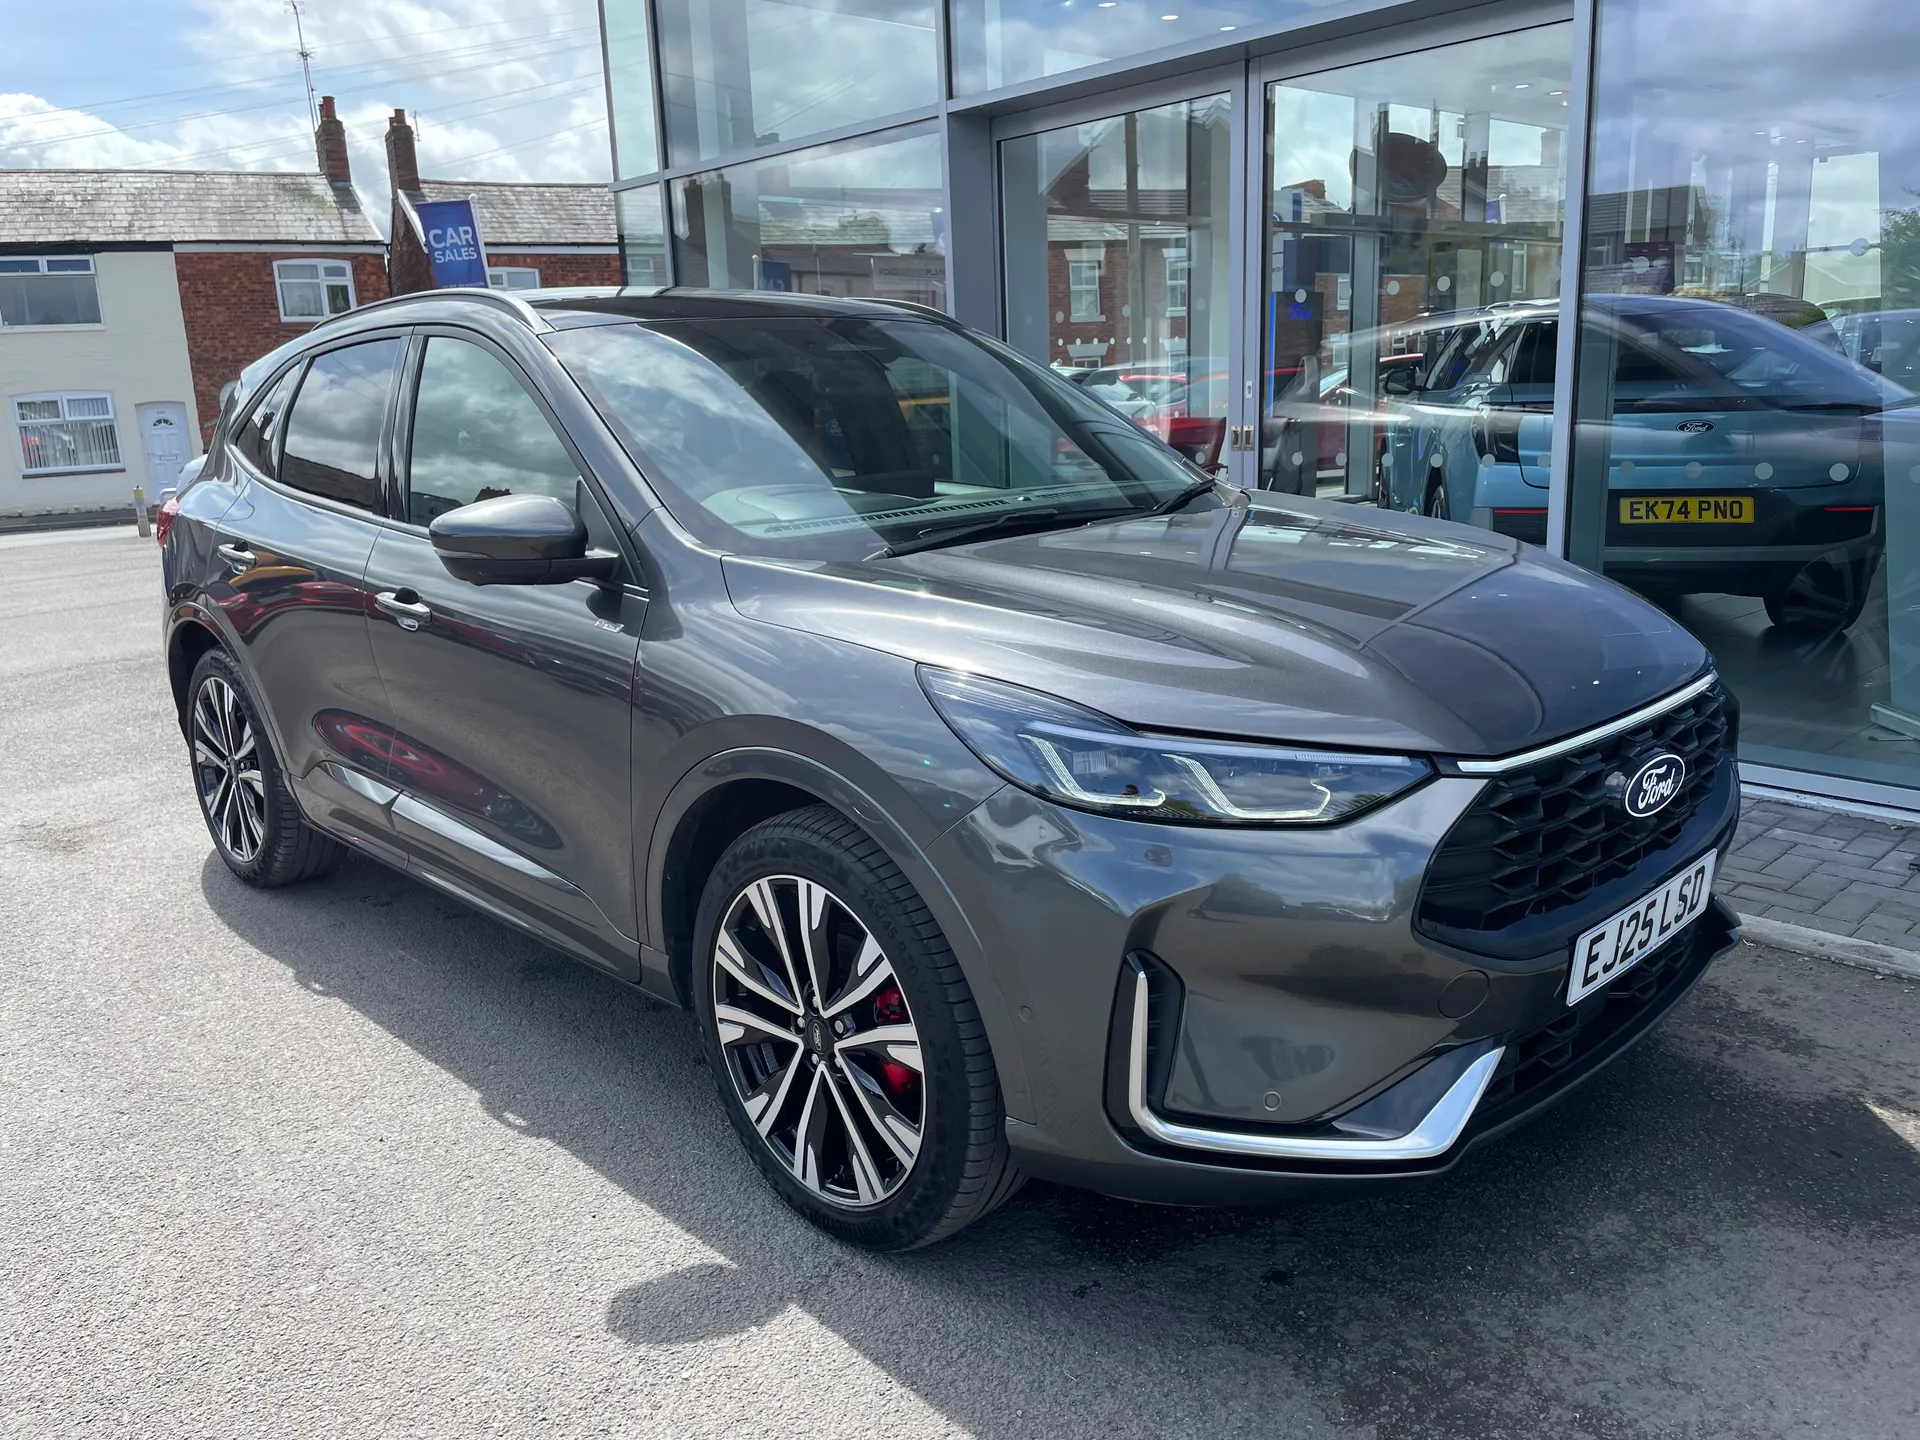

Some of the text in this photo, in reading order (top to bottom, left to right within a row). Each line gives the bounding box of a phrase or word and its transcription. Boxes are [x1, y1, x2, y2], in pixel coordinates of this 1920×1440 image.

[428, 226, 474, 249] CAR
[434, 247, 478, 264] SALES
[1287, 302, 1312, 320] Ford
[1684, 422, 1708, 433] Ford
[1629, 500, 1743, 520] EK74 PNO
[1638, 764, 1675, 810] Ford
[861, 888, 899, 939] 245/45
[895, 940, 919, 978] R20
[1582, 864, 1706, 989] EJ25 LSD
